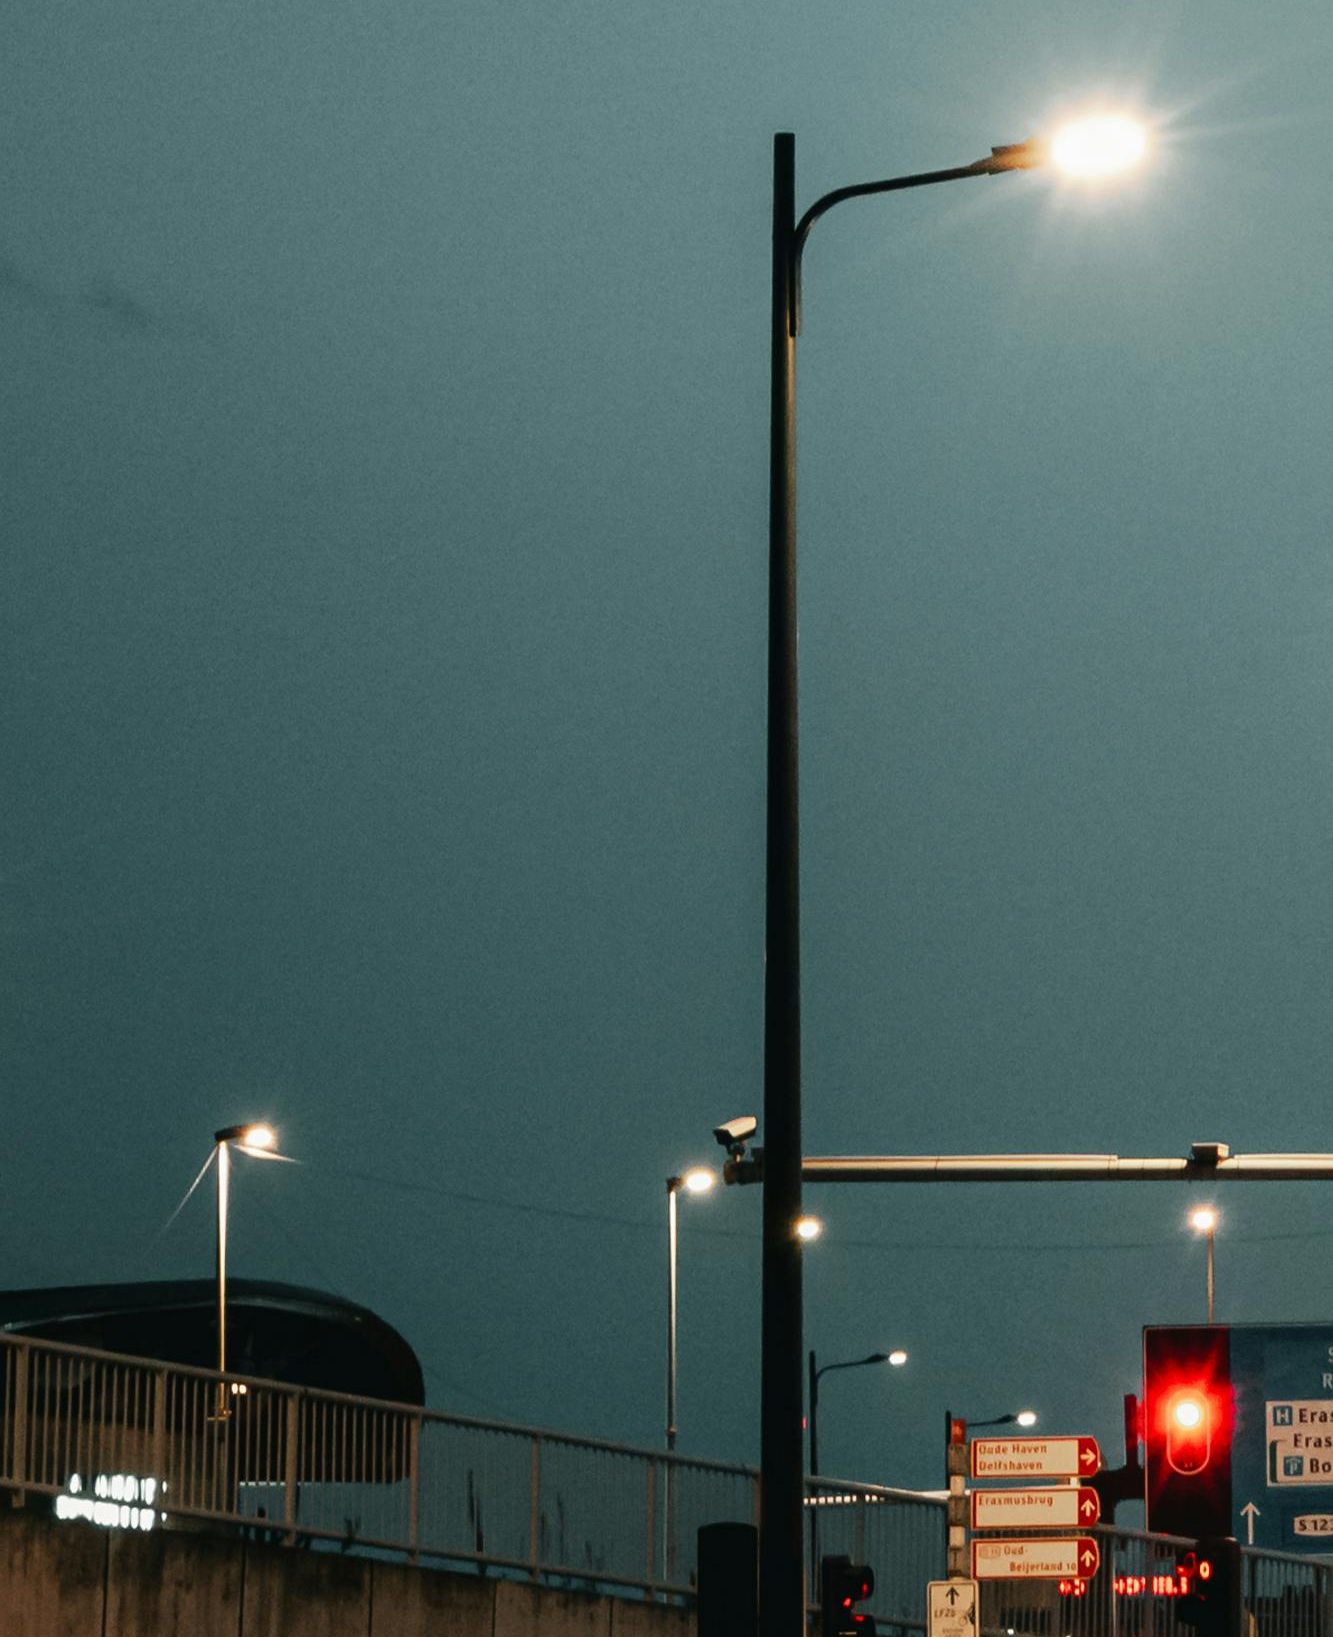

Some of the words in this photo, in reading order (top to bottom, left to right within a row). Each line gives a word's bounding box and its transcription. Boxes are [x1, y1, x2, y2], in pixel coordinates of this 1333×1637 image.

[978, 1444, 1008, 1455] Oude
[1012, 1444, 1048, 1454] Haven
[979, 1460, 1043, 1472] Delfshaven
[978, 1494, 1054, 1507] Erasmusbrug
[1009, 1562, 1063, 1574] Beijerland
